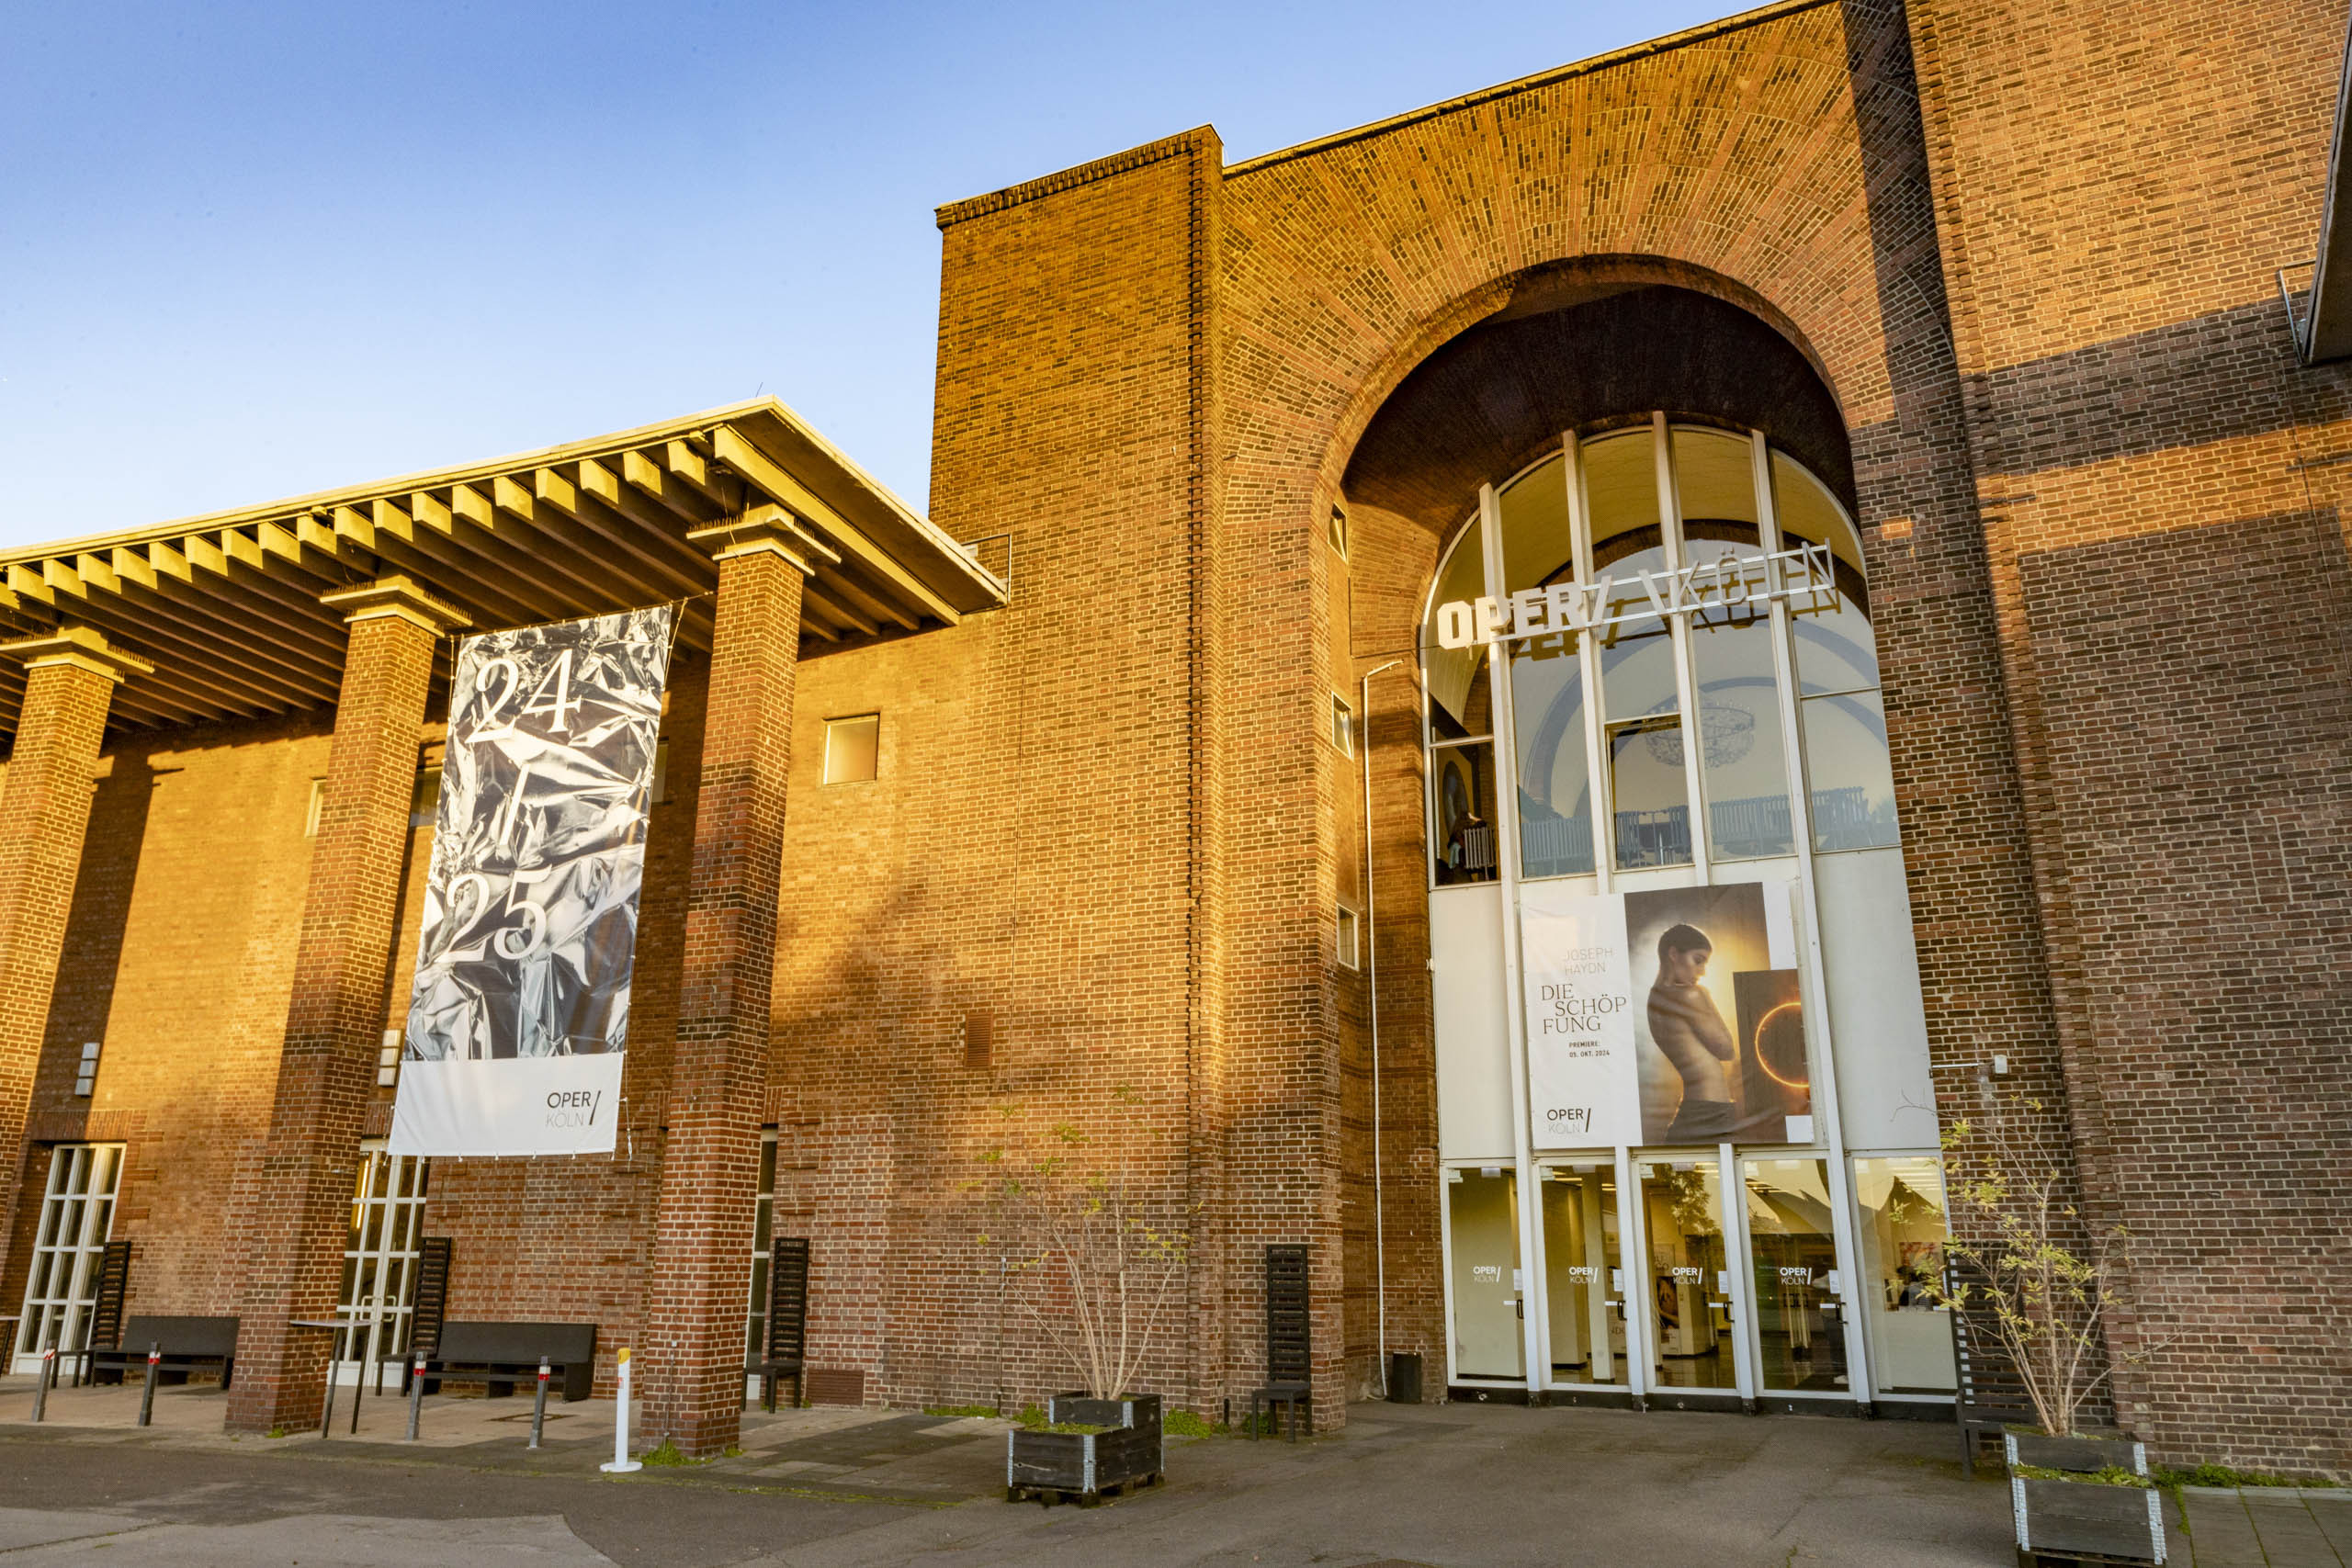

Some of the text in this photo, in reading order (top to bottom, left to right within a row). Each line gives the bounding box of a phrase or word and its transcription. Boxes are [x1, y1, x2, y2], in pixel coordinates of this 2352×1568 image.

[465, 649, 582, 744] 24
[433, 863, 553, 964] 25
[1564, 947, 1613, 962] JOSEPH
[1565, 962, 1607, 976] HAYDN
[1542, 983, 1574, 1001] DIE
[1555, 994, 1627, 1017] SCHÖP
[1544, 1015, 1601, 1034] FUNG
